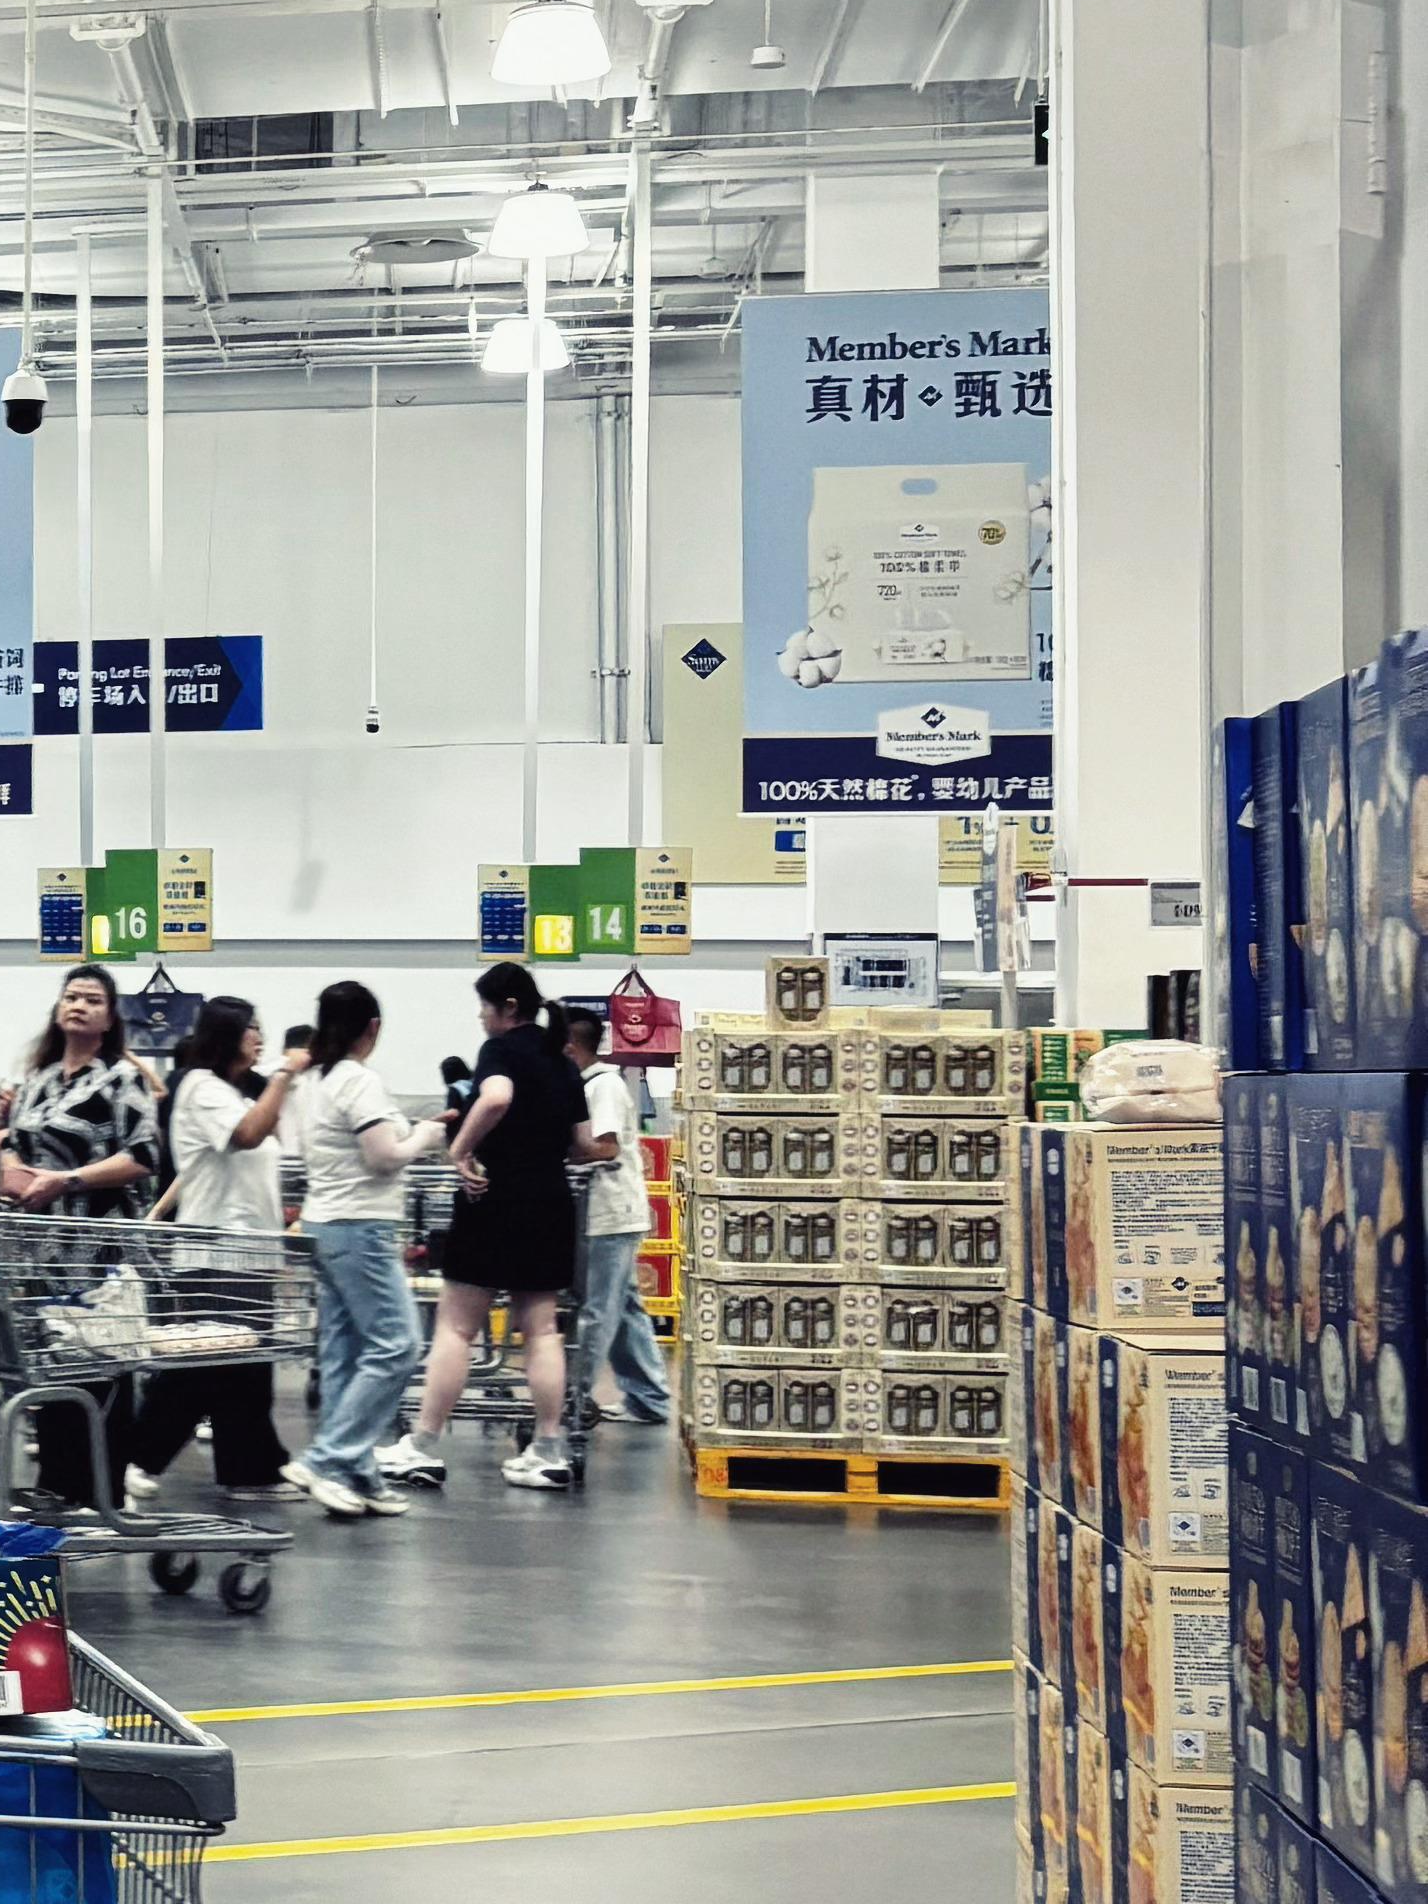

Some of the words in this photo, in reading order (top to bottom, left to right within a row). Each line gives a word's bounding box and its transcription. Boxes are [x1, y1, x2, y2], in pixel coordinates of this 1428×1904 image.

[806, 334, 960, 363] Member's
[804, 372, 909, 422] 真材
[57, 666, 108, 681] Paring
[110, 666, 131, 680] Lot
[886, 732, 945, 741] Member's
[948, 731, 981, 741] Mark
[115, 907, 147, 940] 16
[541, 920, 570, 951] 13
[589, 907, 622, 940] 14
